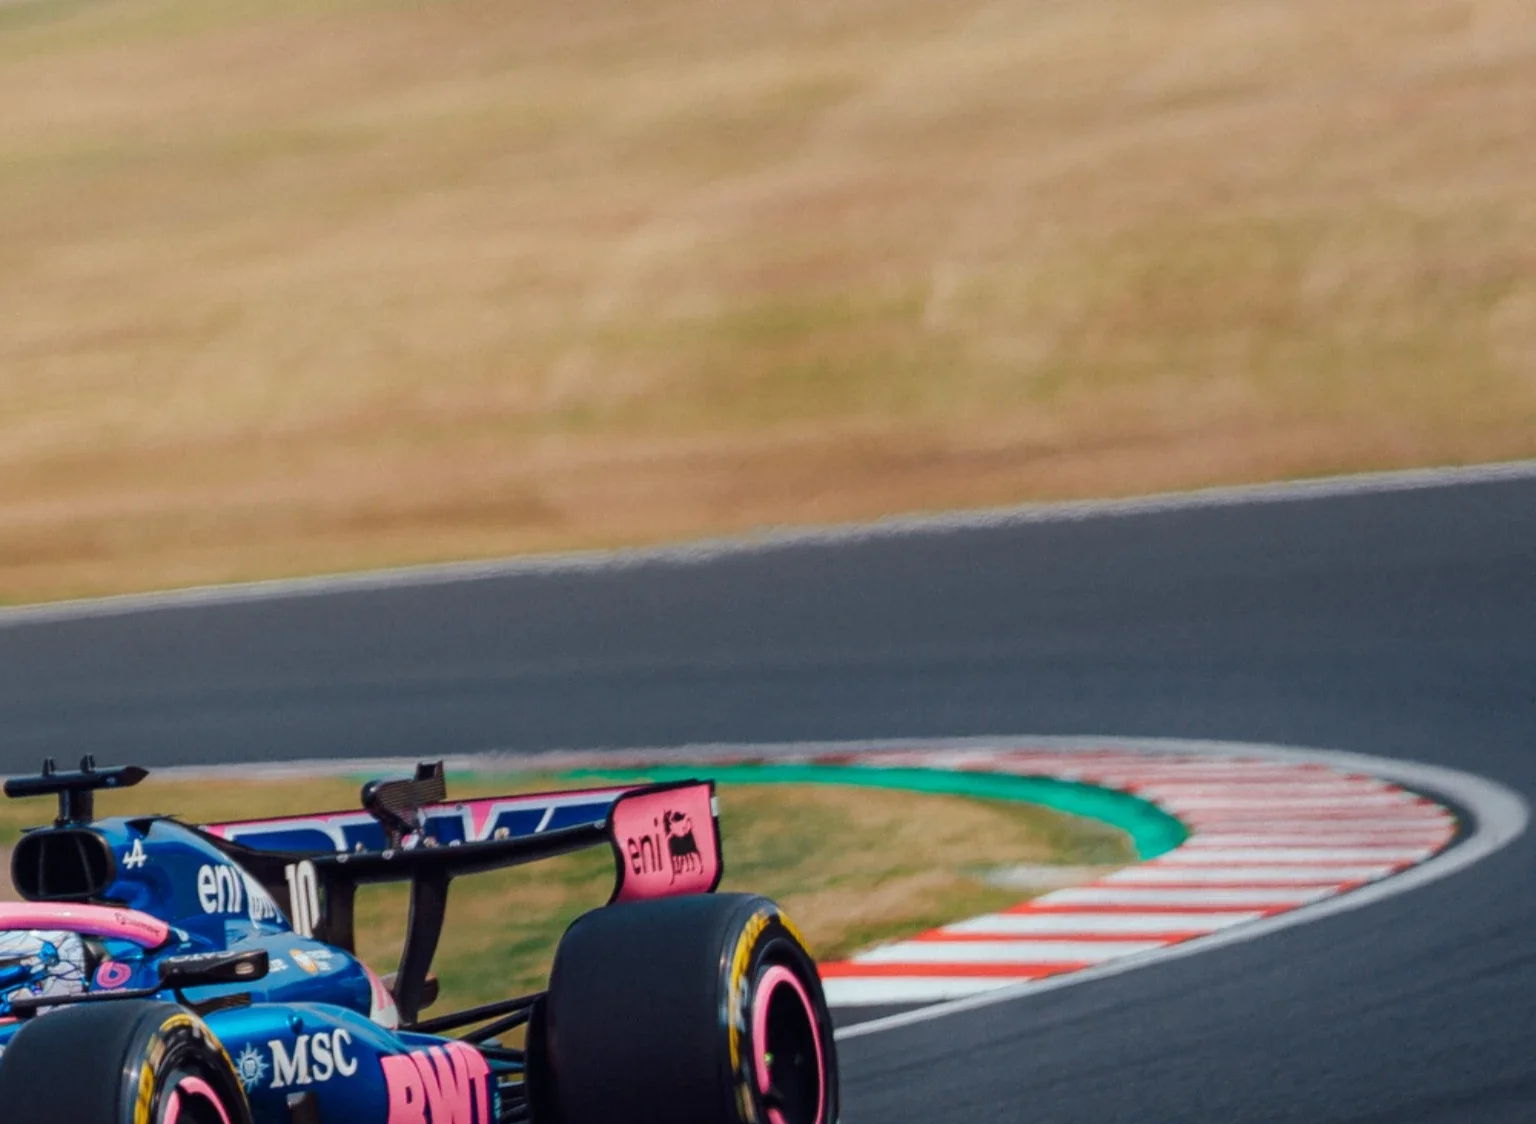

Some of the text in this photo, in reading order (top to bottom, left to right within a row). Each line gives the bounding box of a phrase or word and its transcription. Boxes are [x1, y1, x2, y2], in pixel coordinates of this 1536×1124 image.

[627, 817, 663, 876] eni
[197, 864, 243, 914] eni
[285, 860, 321, 939] 10
[267, 1028, 357, 1088] MSC
